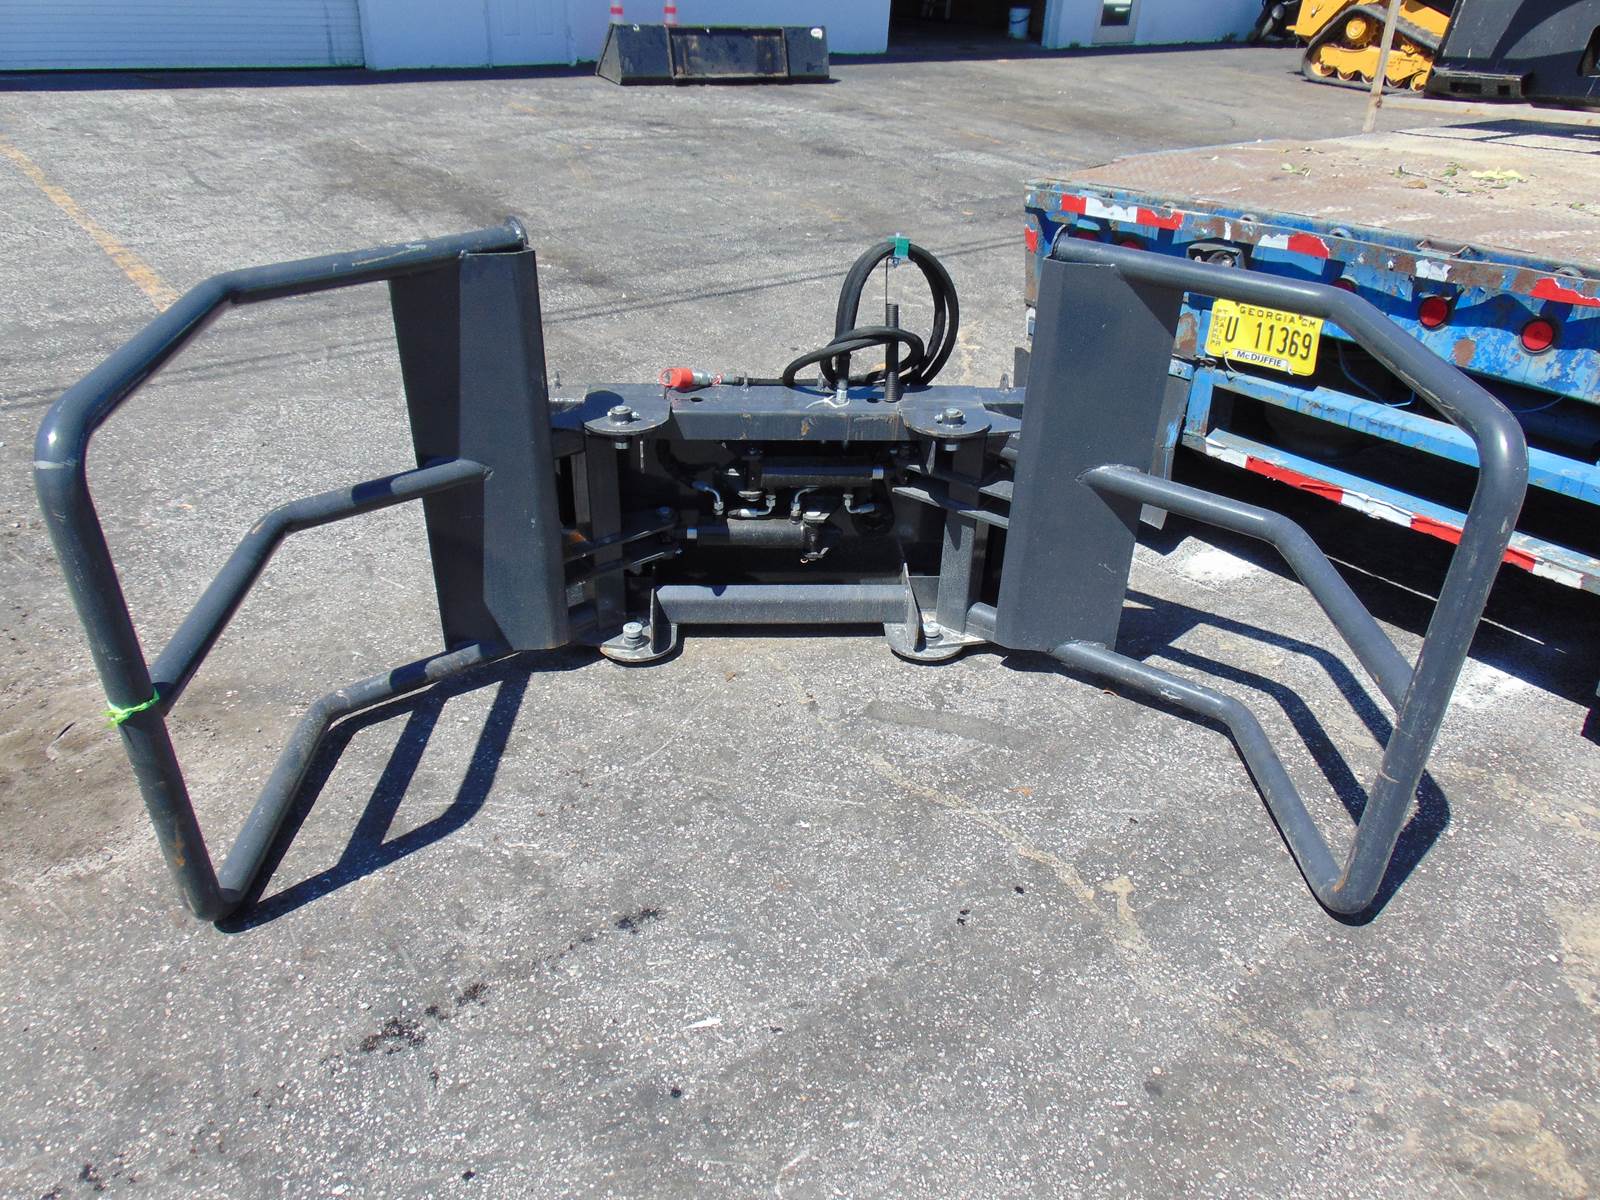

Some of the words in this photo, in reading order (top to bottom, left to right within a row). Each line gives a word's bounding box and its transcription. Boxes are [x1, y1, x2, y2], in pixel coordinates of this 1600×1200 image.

[1239, 305, 1296, 324] GEORGIA
[1225, 315, 1239, 343] U
[1254, 321, 1313, 361] 11369
